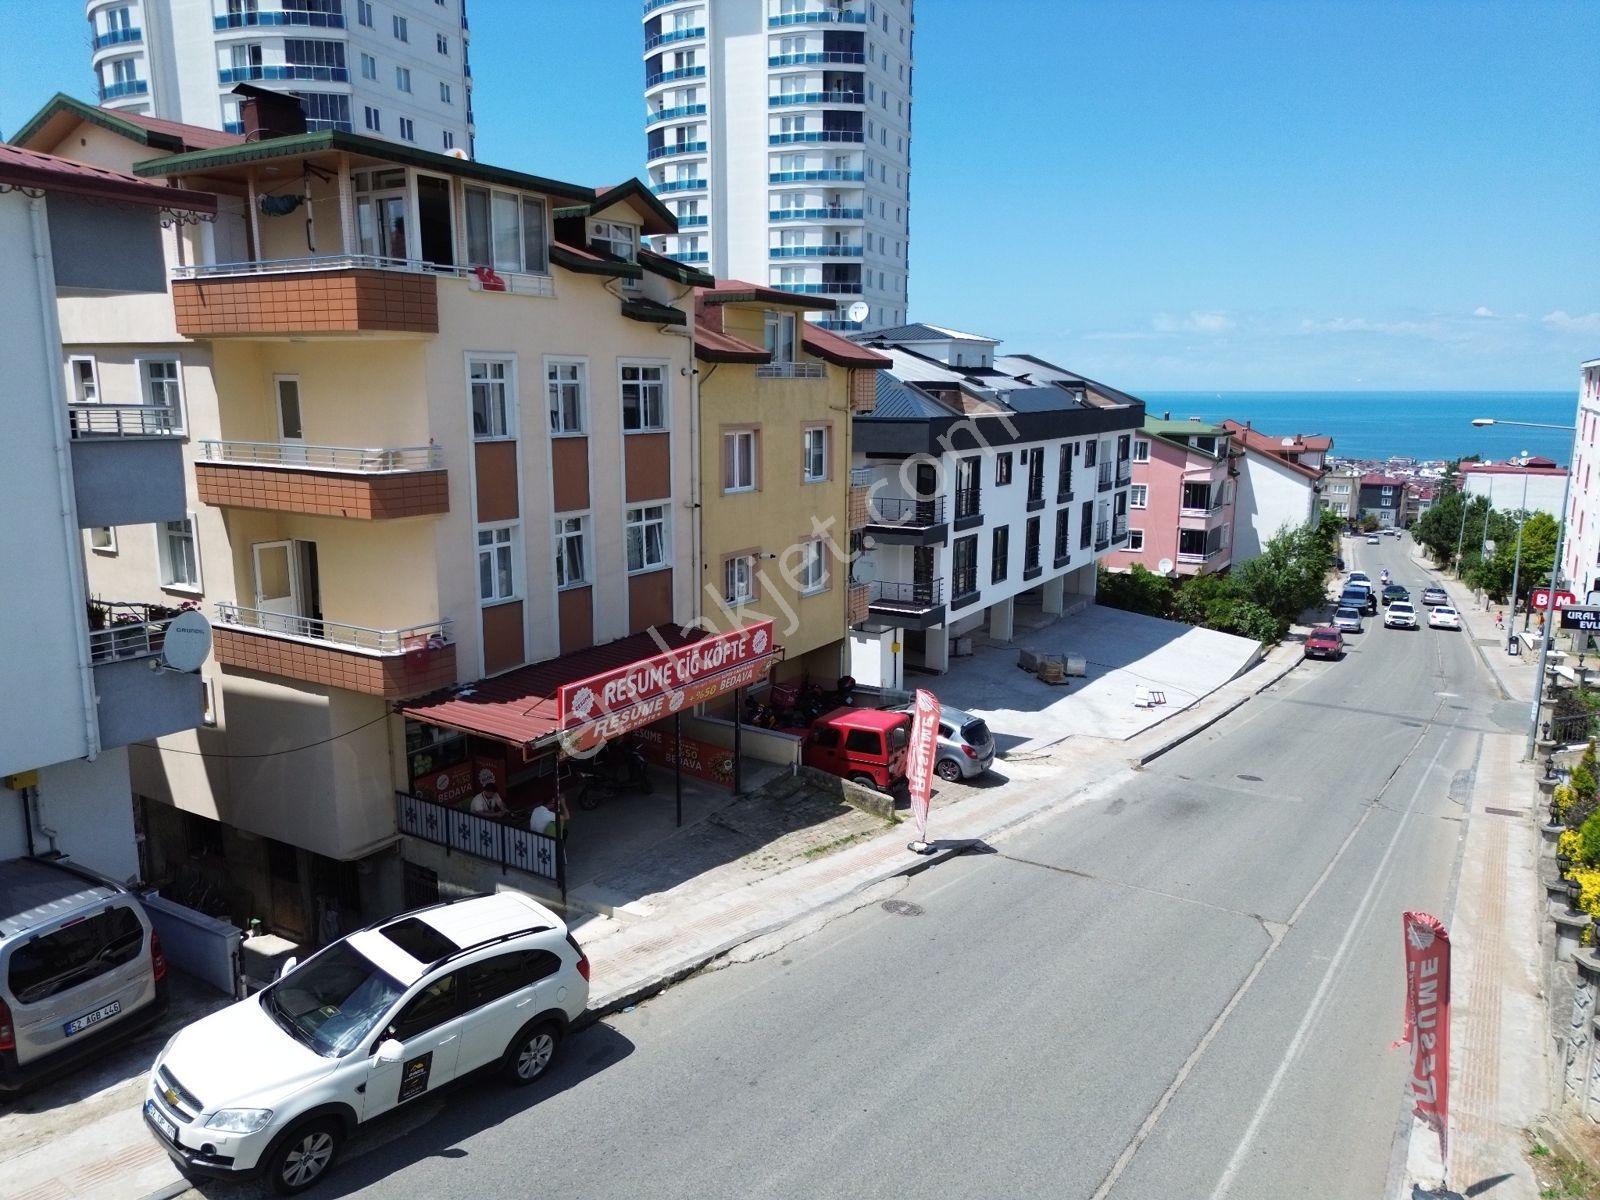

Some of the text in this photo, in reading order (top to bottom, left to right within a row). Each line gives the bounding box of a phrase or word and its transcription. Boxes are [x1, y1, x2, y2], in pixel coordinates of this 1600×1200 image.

[1536, 593, 1571, 606] BM
[1567, 611, 1596, 620] URAL
[604, 661, 673, 706] RESUME
[676, 649, 700, 682] ÇİĞ
[703, 636, 747, 670] KÖFTE
[719, 669, 753, 691] BEDAVA
[593, 697, 664, 738] RESUME
[71, 1004, 119, 1031] 52 AGB 446
